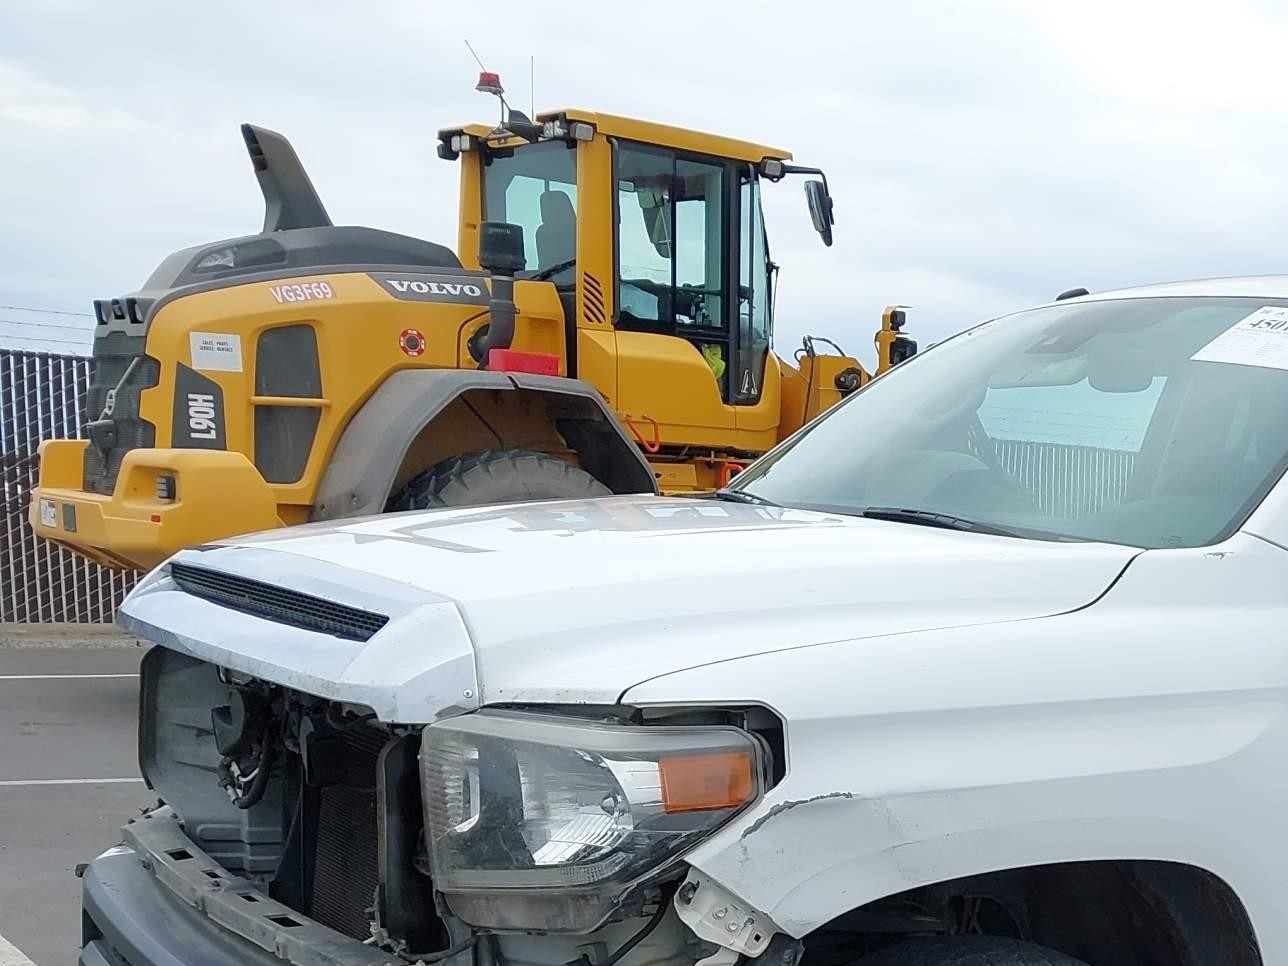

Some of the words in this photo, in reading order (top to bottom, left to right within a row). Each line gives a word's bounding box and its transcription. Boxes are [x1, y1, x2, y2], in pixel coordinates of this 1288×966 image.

[269, 281, 333, 304] VG3F69
[387, 279, 481, 298] VOLVO
[187, 393, 217, 439] L90H
